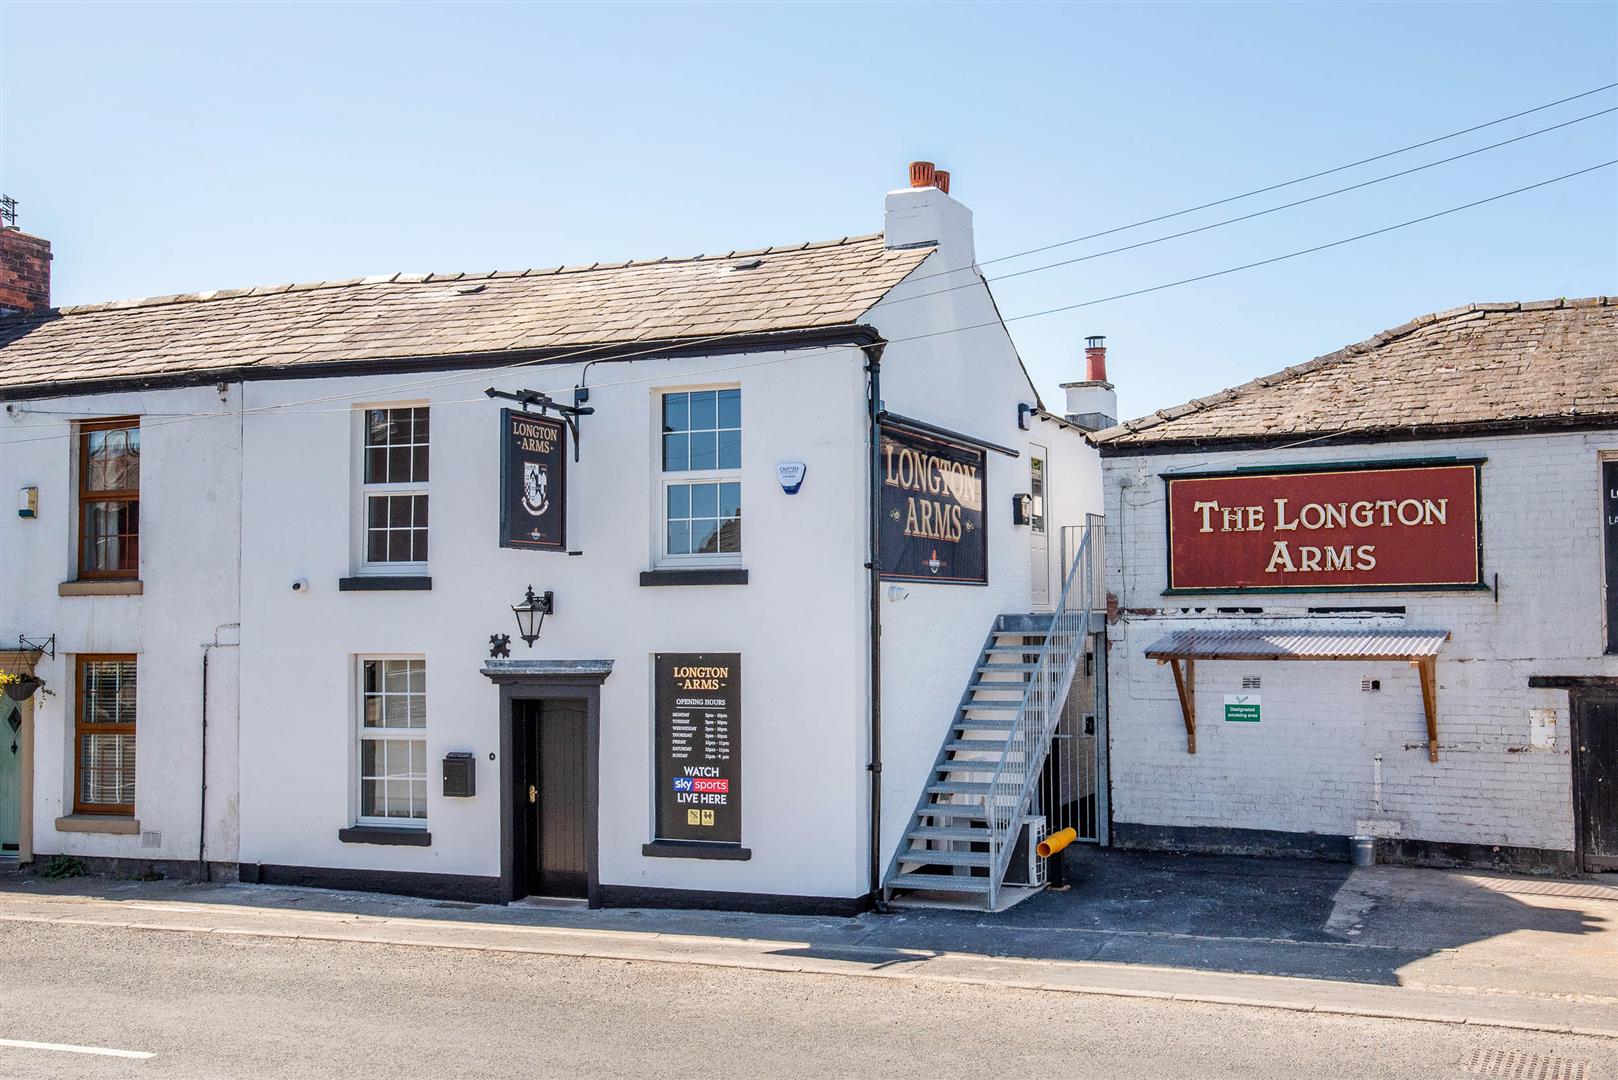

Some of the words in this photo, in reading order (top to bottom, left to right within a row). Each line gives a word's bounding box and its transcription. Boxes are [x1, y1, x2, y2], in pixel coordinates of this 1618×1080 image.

[513, 422, 558, 441] LONGTON
[522, 438, 550, 453] ARMS
[885, 444, 976, 500] LONGTON
[904, 496, 962, 543] ARMS
[1194, 500, 1265, 532] THE
[1273, 498, 1448, 531] LONGTON
[1265, 541, 1376, 573] ARMS
[673, 667, 728, 678] LONGTON
[683, 679, 719, 690] ARMS
[684, 766, 719, 777] WATCH
[675, 779, 692, 791] sky
[695, 781, 727, 790] sports
[677, 793, 698, 804] LIVE
[701, 794, 727, 805] HERE
